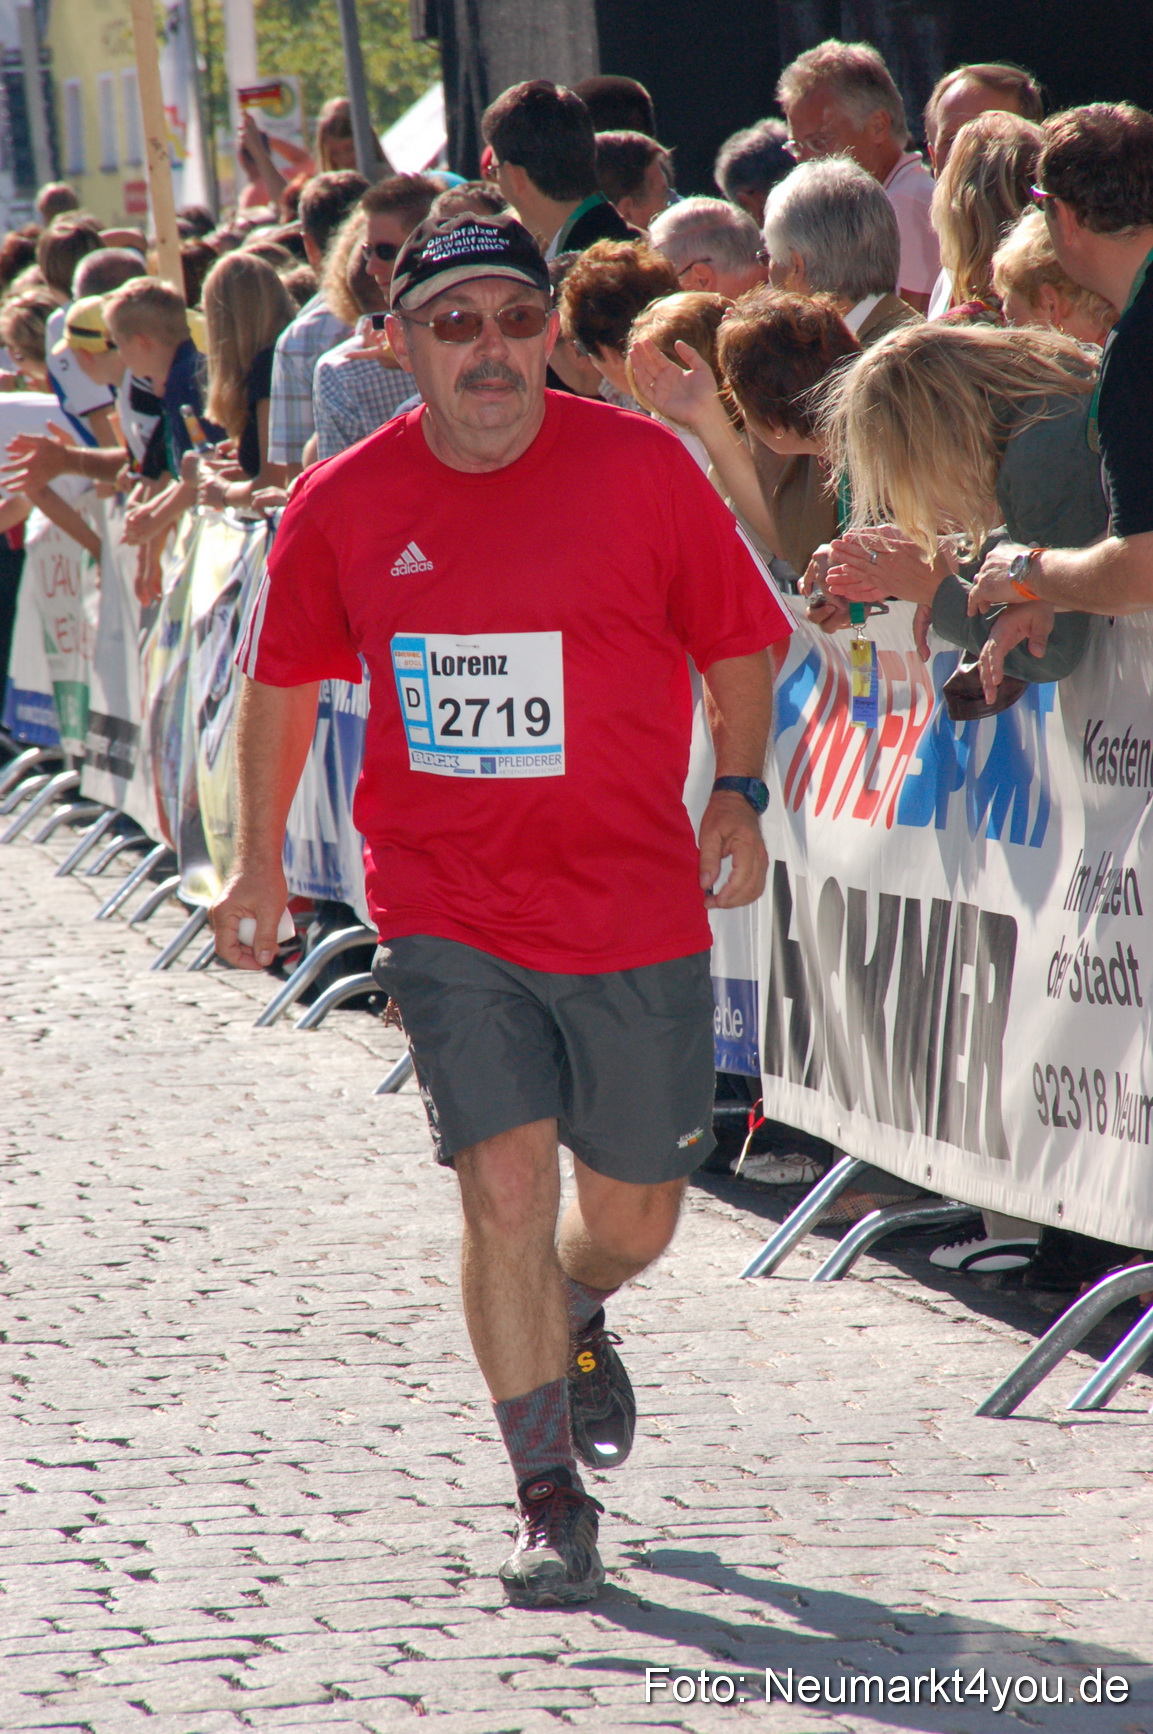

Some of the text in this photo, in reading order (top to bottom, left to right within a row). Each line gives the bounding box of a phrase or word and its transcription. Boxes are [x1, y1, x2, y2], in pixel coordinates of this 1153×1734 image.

[390, 560, 434, 577] adidas
[430, 651, 508, 676] Lorenz
[405, 687, 421, 708] D
[438, 696, 551, 737] 2719
[411, 751, 460, 769] BOCK
[498, 754, 562, 767] PFLEIDERER
[1082, 718, 1153, 789] Kasten
[1063, 849, 1092, 913] Im
[1046, 934, 1143, 1008] der Stadt
[1032, 1062, 1108, 1136] 92318
